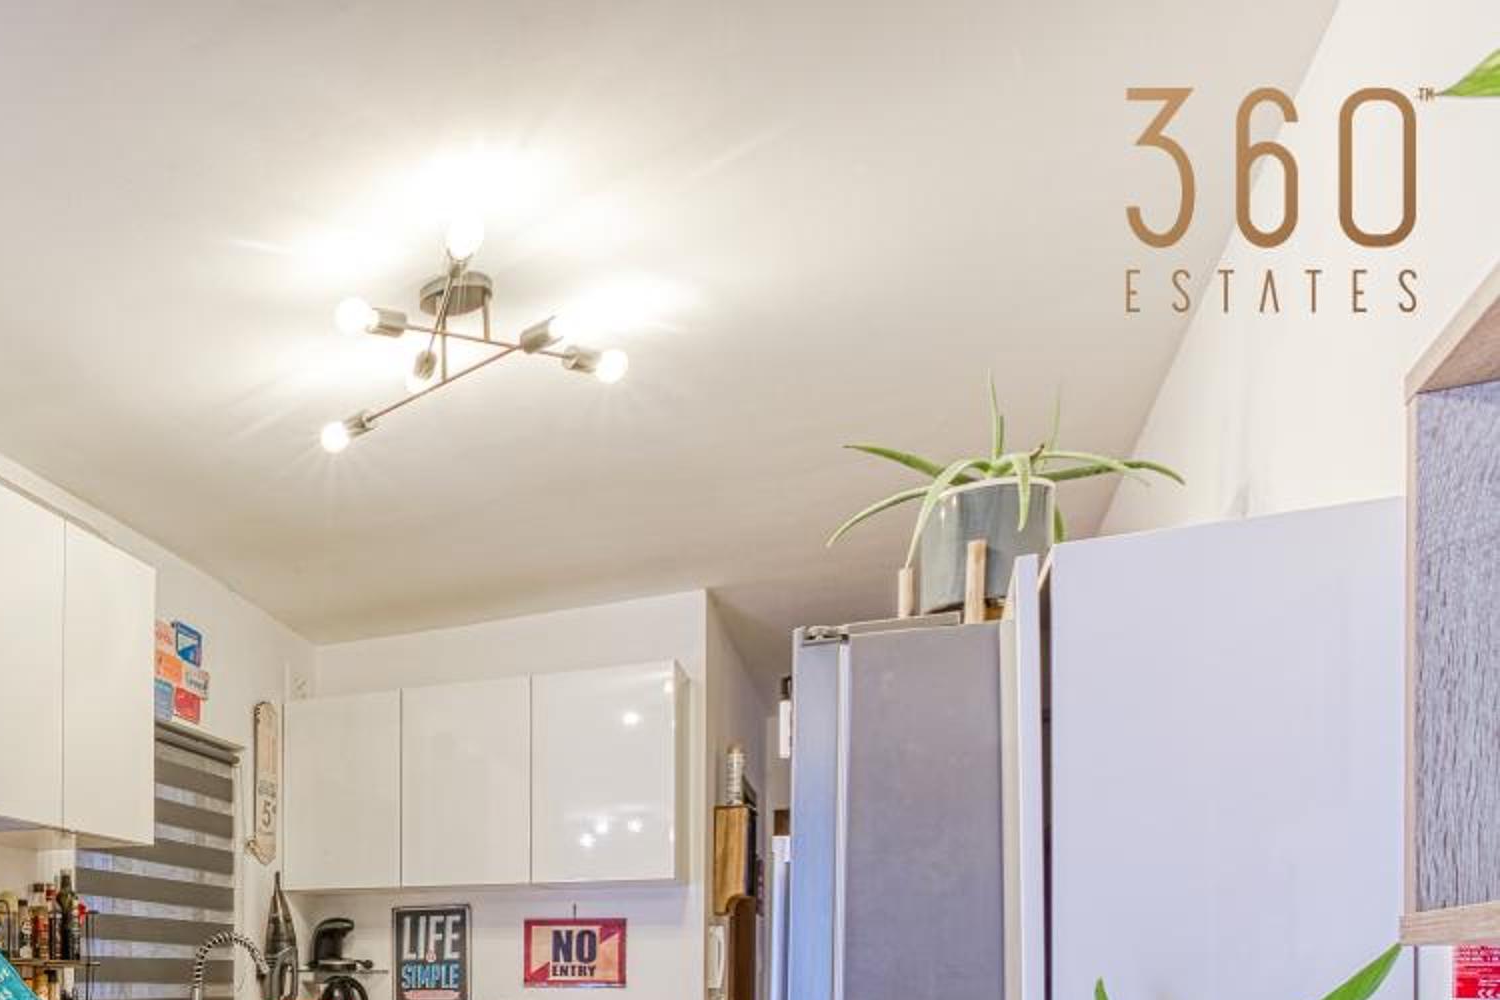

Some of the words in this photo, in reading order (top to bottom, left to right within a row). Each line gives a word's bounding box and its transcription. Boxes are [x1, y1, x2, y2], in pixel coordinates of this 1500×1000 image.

[402, 915, 461, 960] LIFE
[551, 929, 597, 964] NO
[401, 962, 460, 989] SIMPLE
[551, 964, 597, 977] ENTRY
